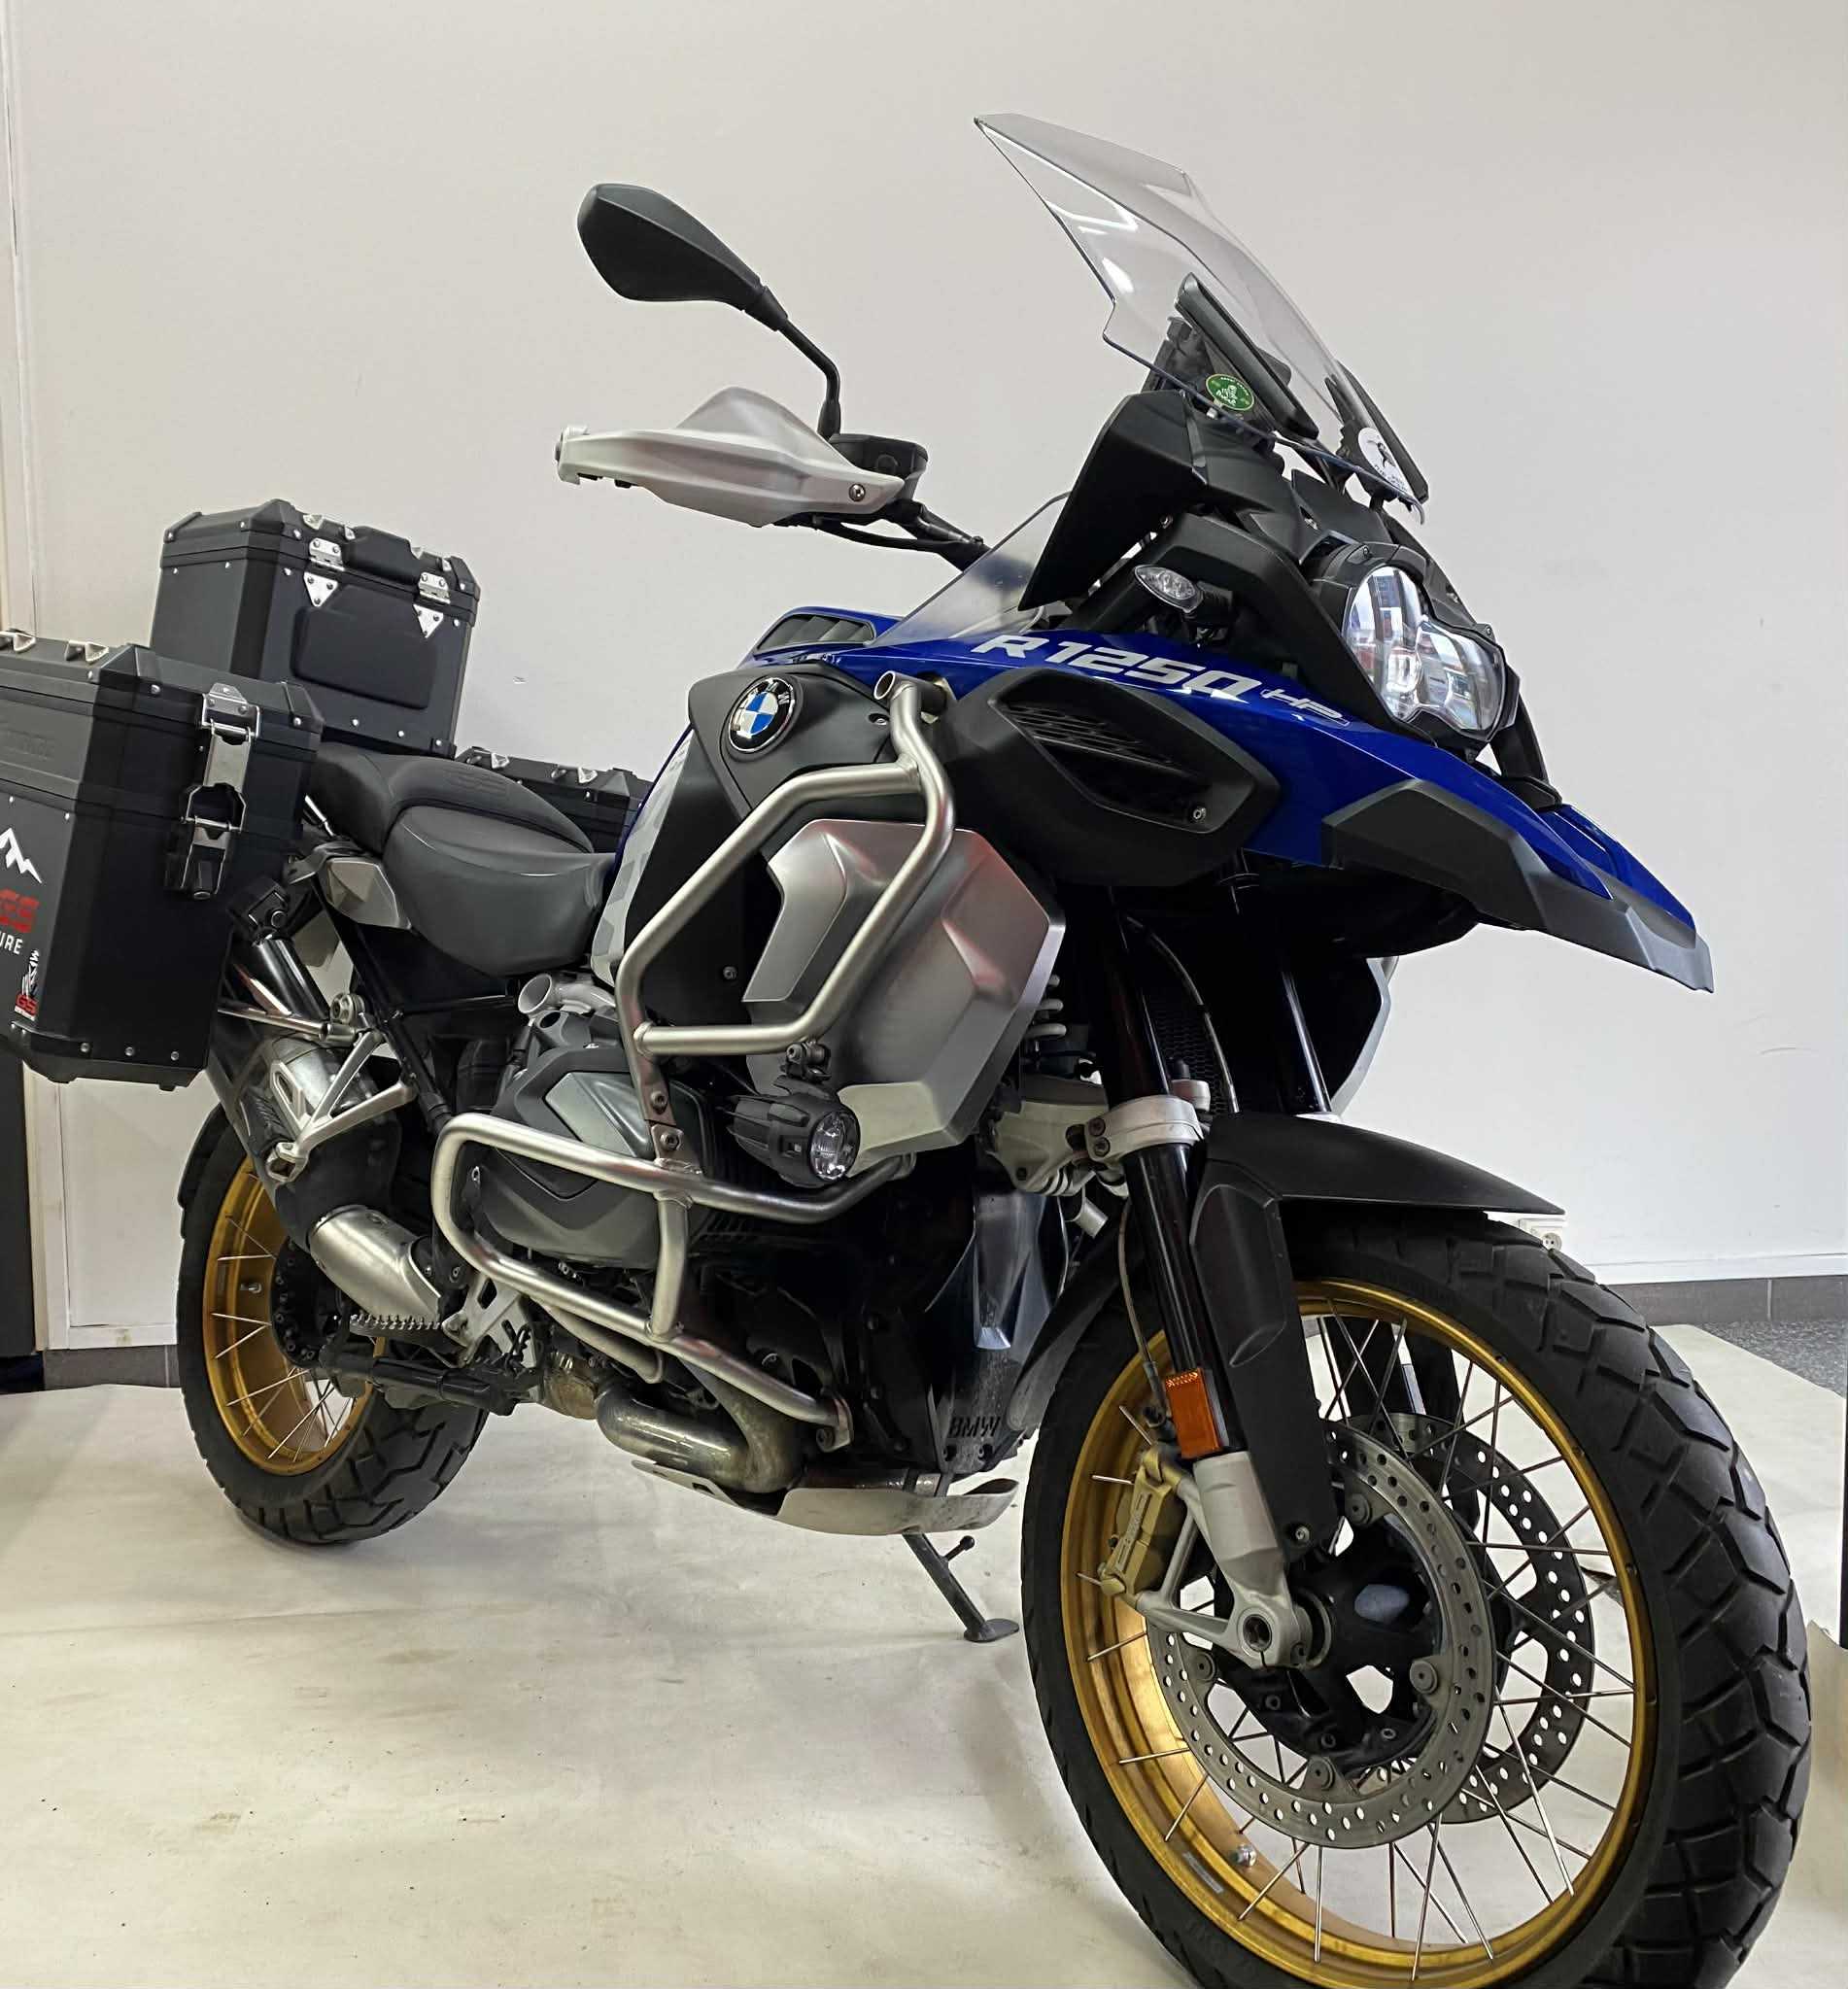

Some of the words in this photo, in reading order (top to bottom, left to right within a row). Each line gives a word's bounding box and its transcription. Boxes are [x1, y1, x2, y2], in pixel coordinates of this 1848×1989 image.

[971, 634, 1049, 659] R
[1045, 640, 1262, 696] 1250
[1260, 688, 1352, 727] HP
[949, 1416, 1001, 1437] BMW
